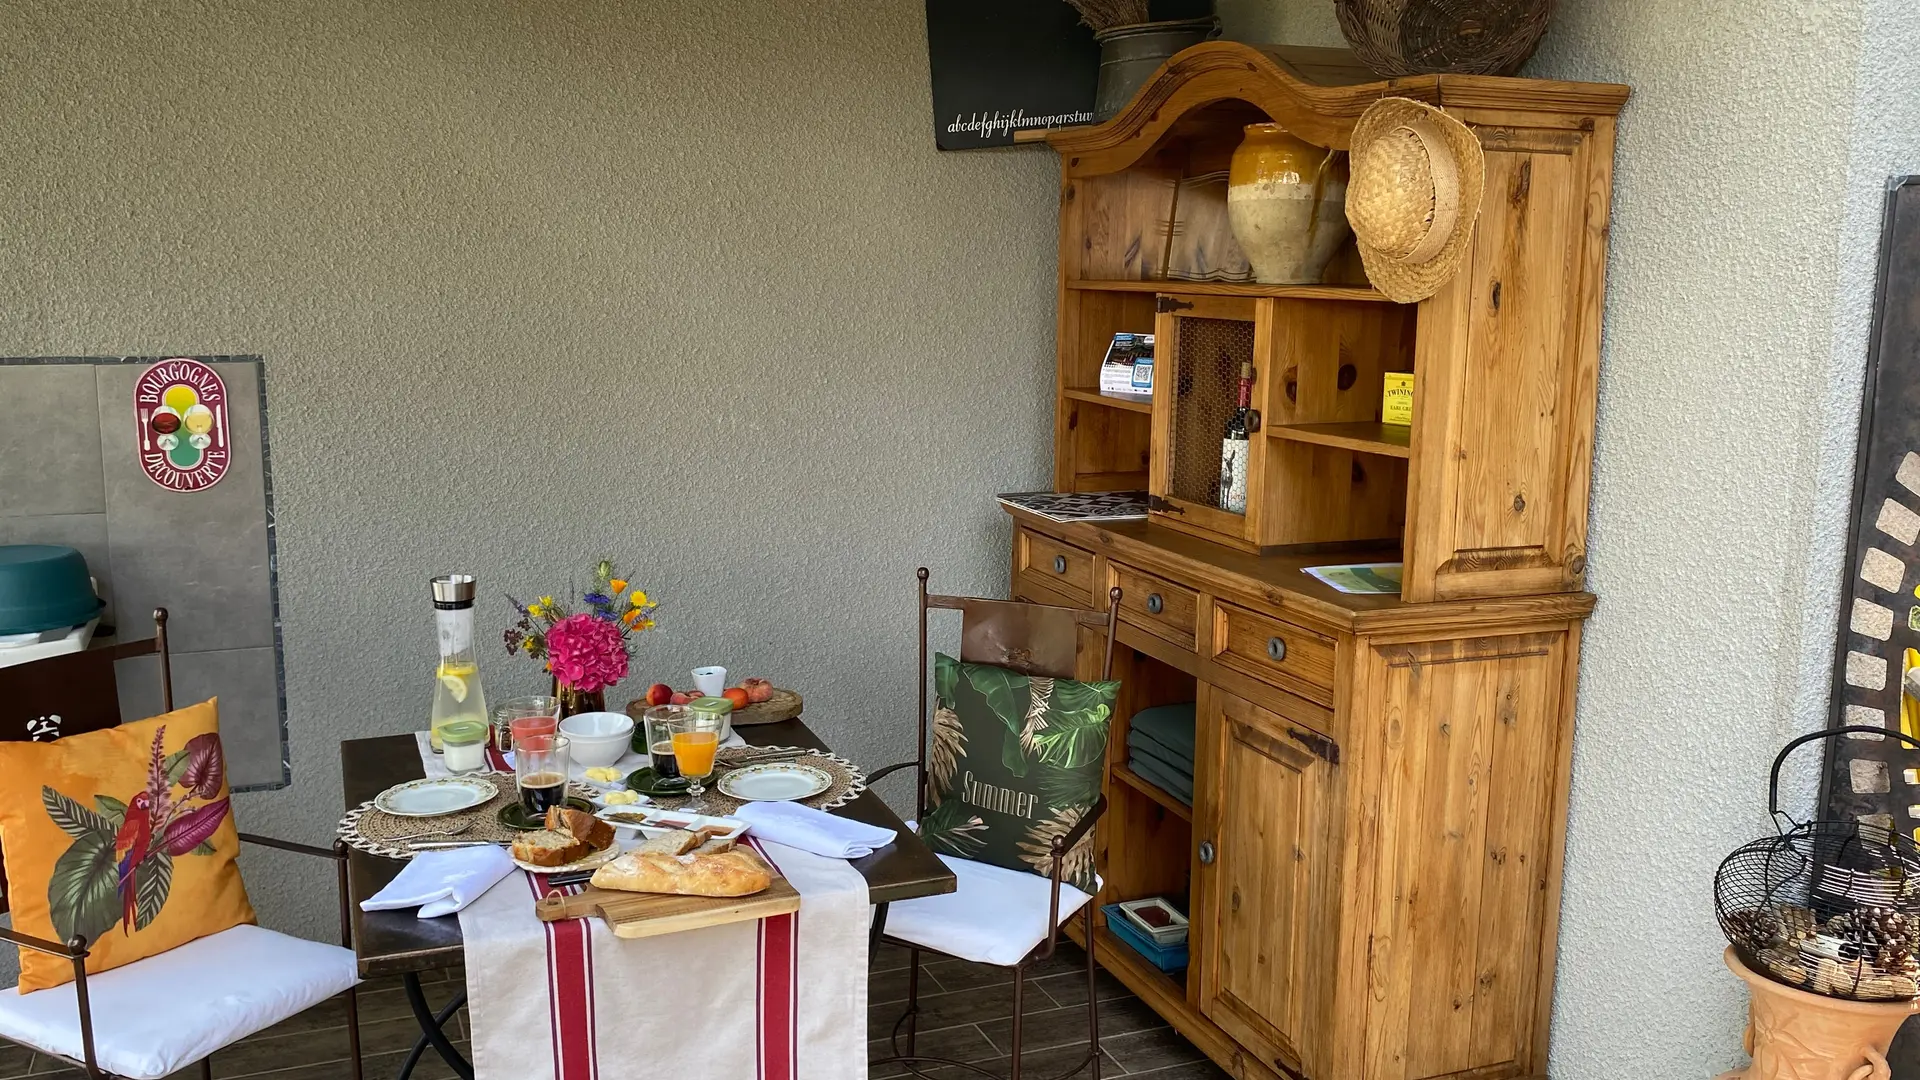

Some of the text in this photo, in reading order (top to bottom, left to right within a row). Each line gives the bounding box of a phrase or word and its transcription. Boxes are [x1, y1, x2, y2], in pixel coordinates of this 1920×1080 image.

[139, 361, 221, 404] BOURGOGNES
[144, 450, 226, 489] DECOUVERTE
[962, 770, 1039, 819] Summer
